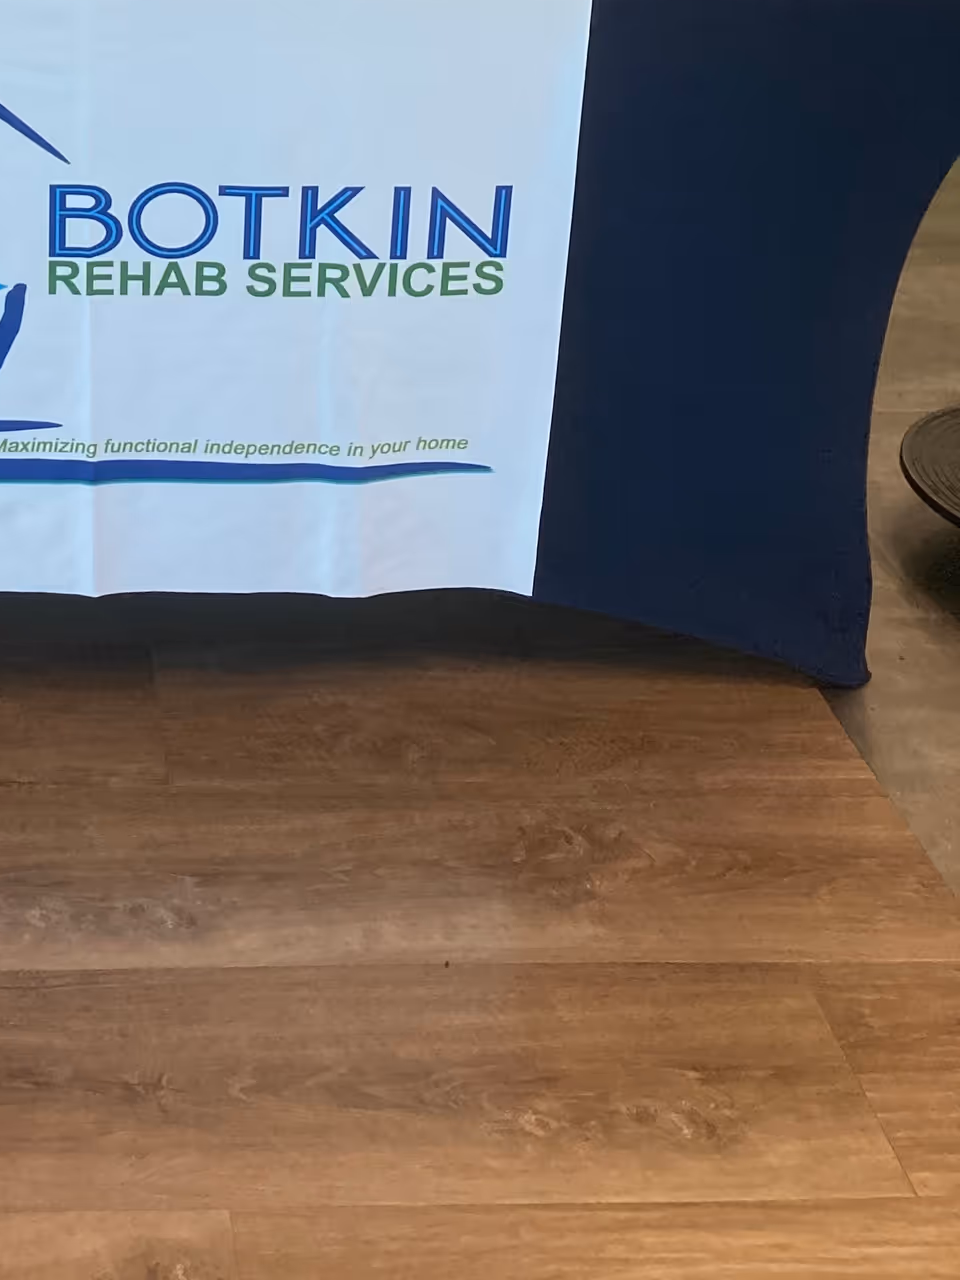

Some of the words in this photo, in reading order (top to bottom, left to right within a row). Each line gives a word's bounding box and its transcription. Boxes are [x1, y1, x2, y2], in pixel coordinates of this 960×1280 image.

[48, 182, 514, 260] BOTKIN
[48, 260, 228, 296] REHAB
[246, 260, 504, 298] SERVICES
[104, 438, 198, 454] functional
[204, 439, 340, 458] independence
[347, 442, 364, 457] in
[369, 440, 412, 460] your
[416, 436, 469, 452] home
